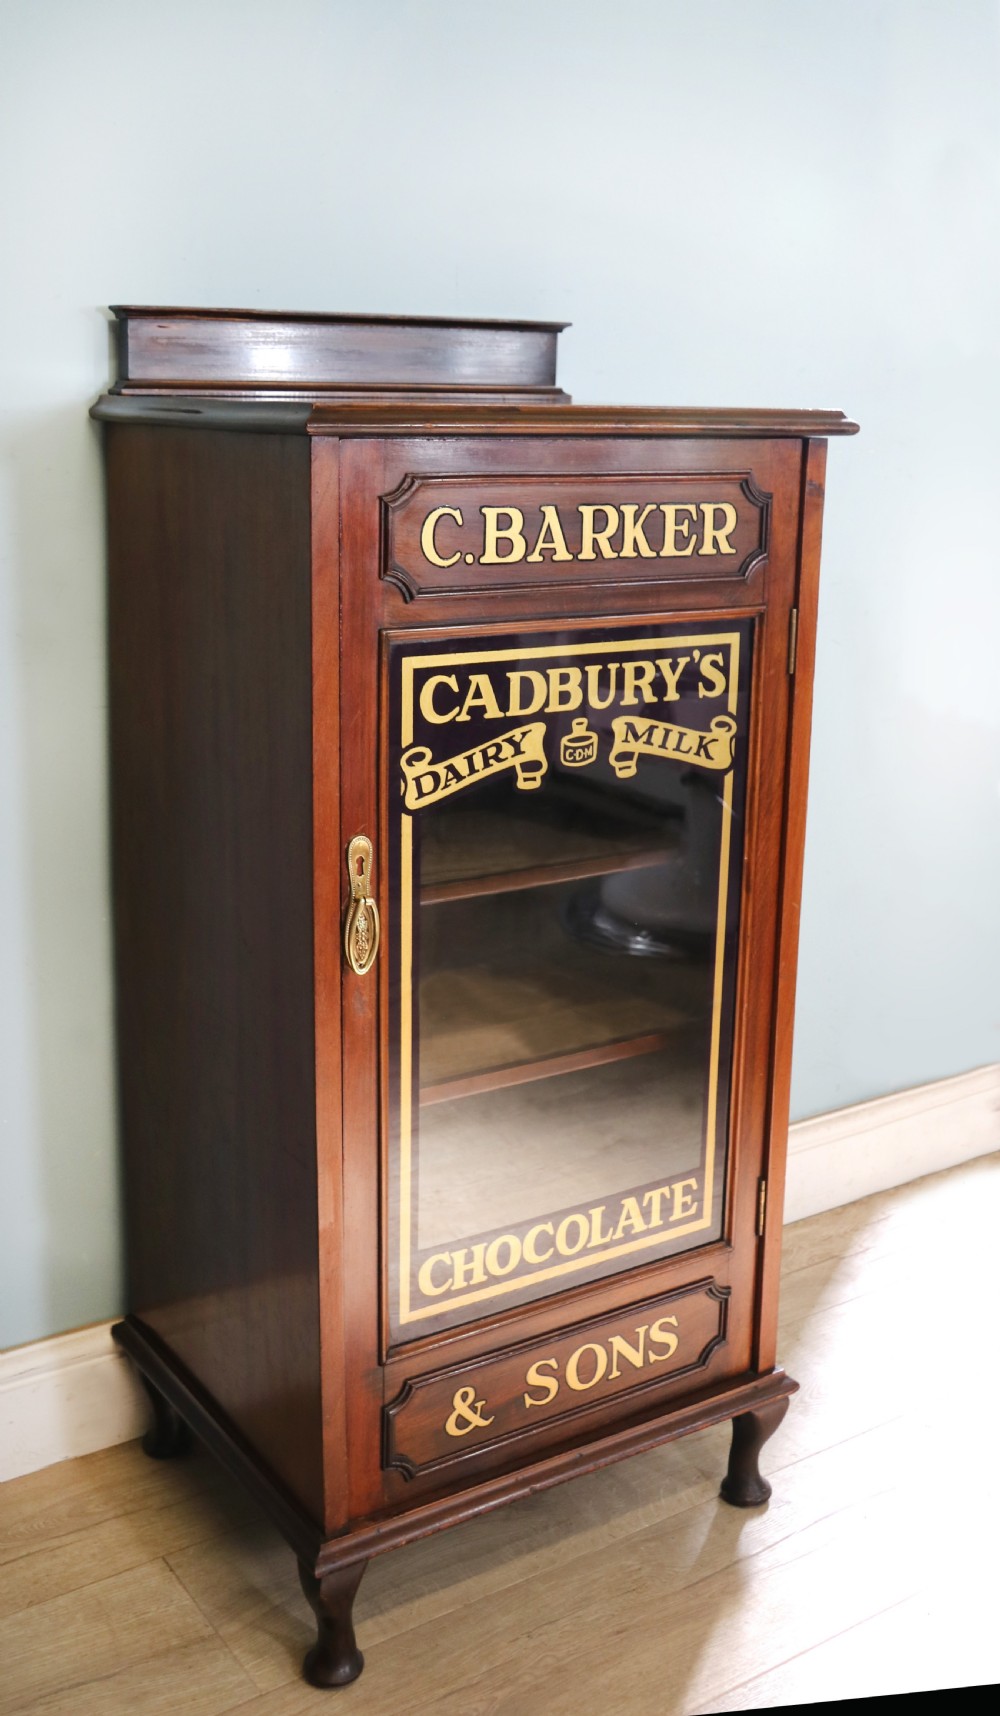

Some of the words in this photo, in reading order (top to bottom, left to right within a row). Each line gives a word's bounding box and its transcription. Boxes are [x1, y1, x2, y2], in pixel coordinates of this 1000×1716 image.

[418, 649, 727, 725] CADBURY'S
[412, 728, 534, 801] DAIRY
[621, 721, 720, 762] MILK
[417, 1177, 699, 1297] CHOCOLATE
[444, 1386, 495, 1437] &
[523, 1315, 680, 1409] SONS
